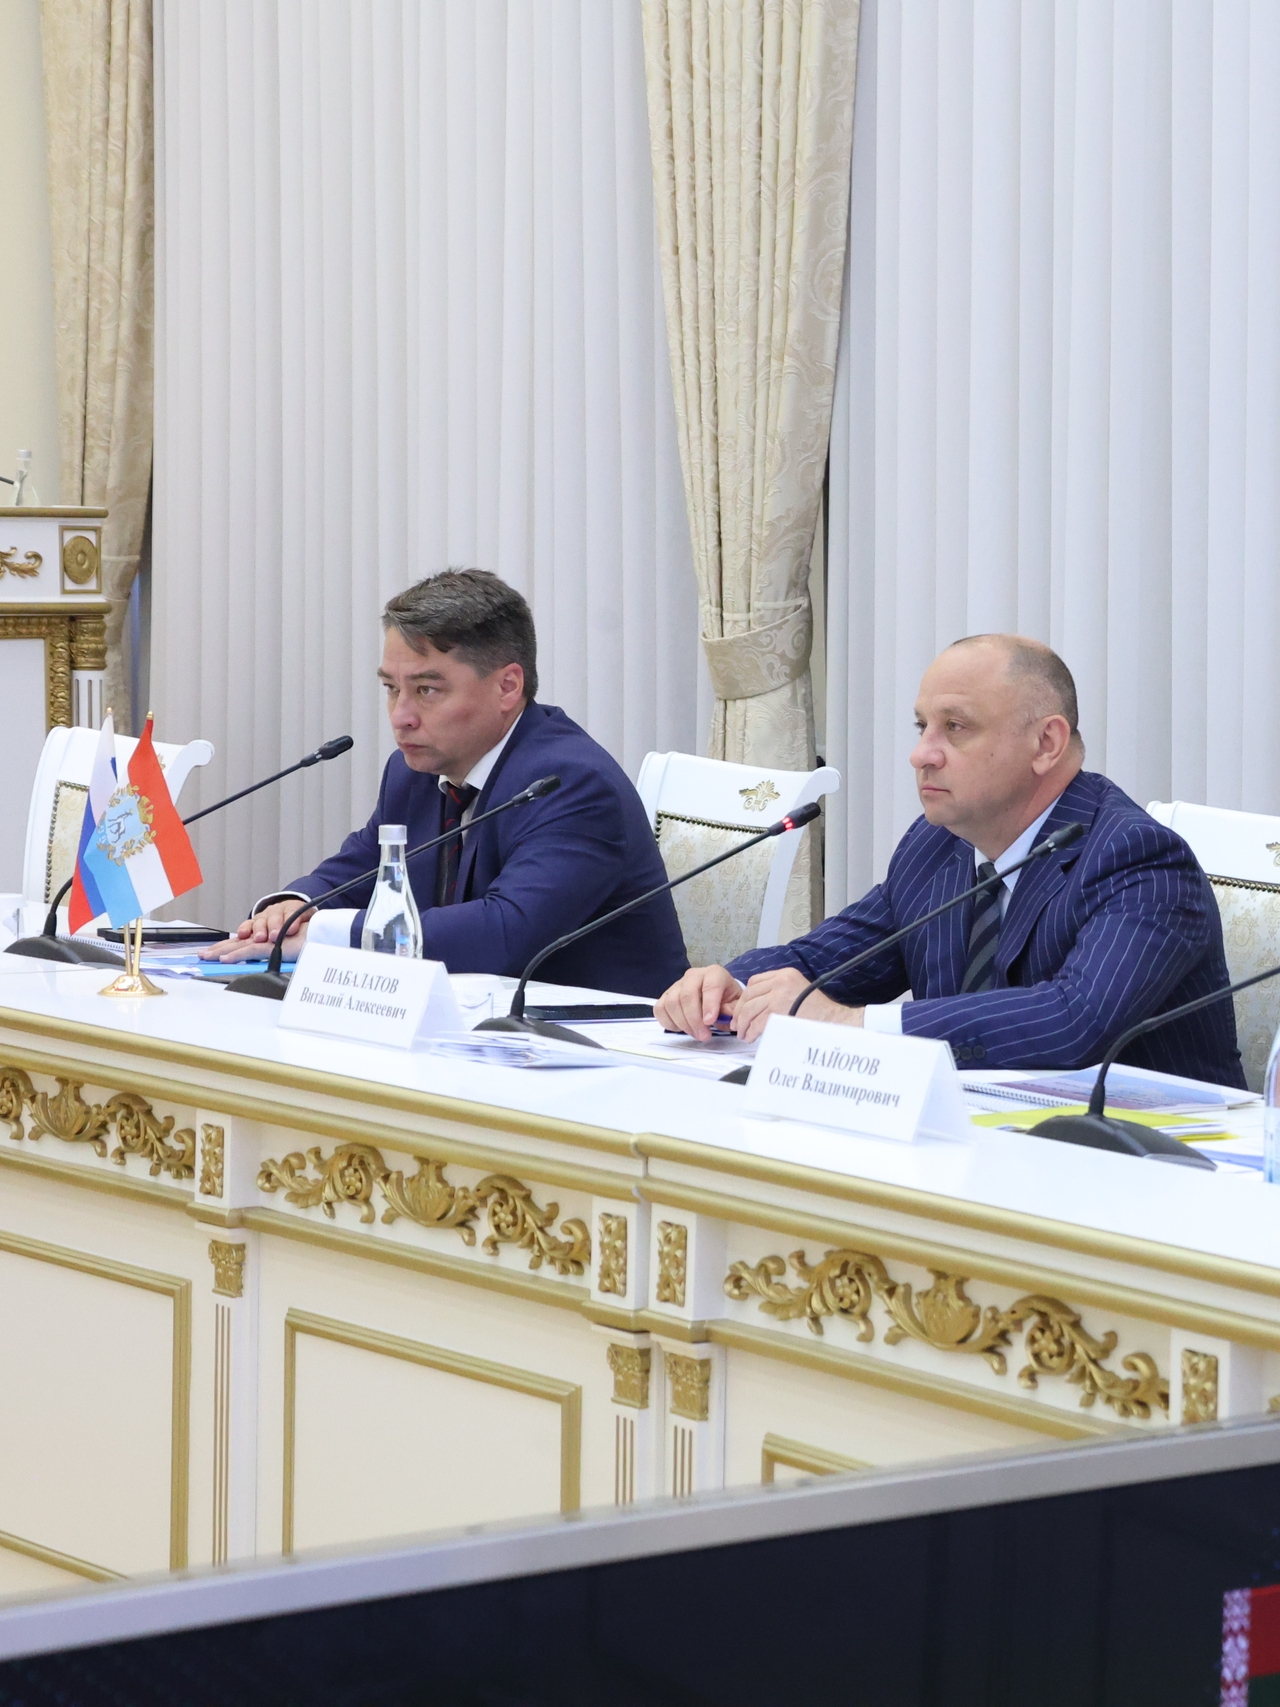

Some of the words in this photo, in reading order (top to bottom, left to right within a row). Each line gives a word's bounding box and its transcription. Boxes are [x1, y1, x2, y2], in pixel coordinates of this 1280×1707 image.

[322, 967, 400, 994] ШАБАЛАТОВ
[300, 986, 344, 1008] Виталий
[343, 995, 407, 1020] Алексеевич
[803, 1046, 880, 1076] МАЙОРОВ
[768, 1067, 800, 1088] Олег
[801, 1073, 900, 1108] Владимирович
